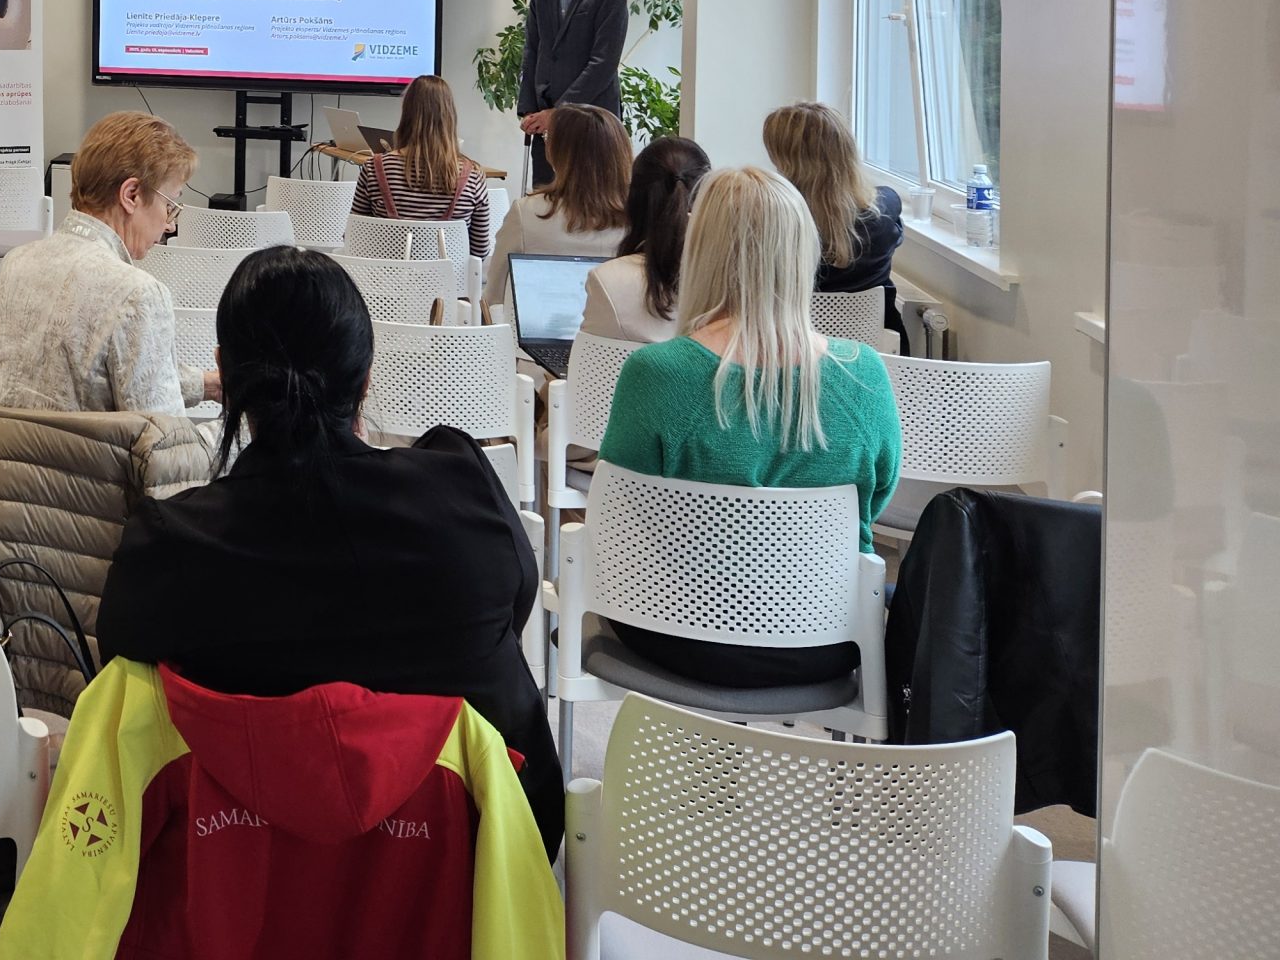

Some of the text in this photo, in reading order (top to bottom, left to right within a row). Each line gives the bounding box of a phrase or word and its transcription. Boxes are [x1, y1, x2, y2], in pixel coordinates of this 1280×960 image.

[270, 16, 297, 24] Artūrs
[369, 44, 419, 56] VIDZEME
[81, 816, 95, 833] S
[196, 808, 431, 840] SAMAR NĪBA
